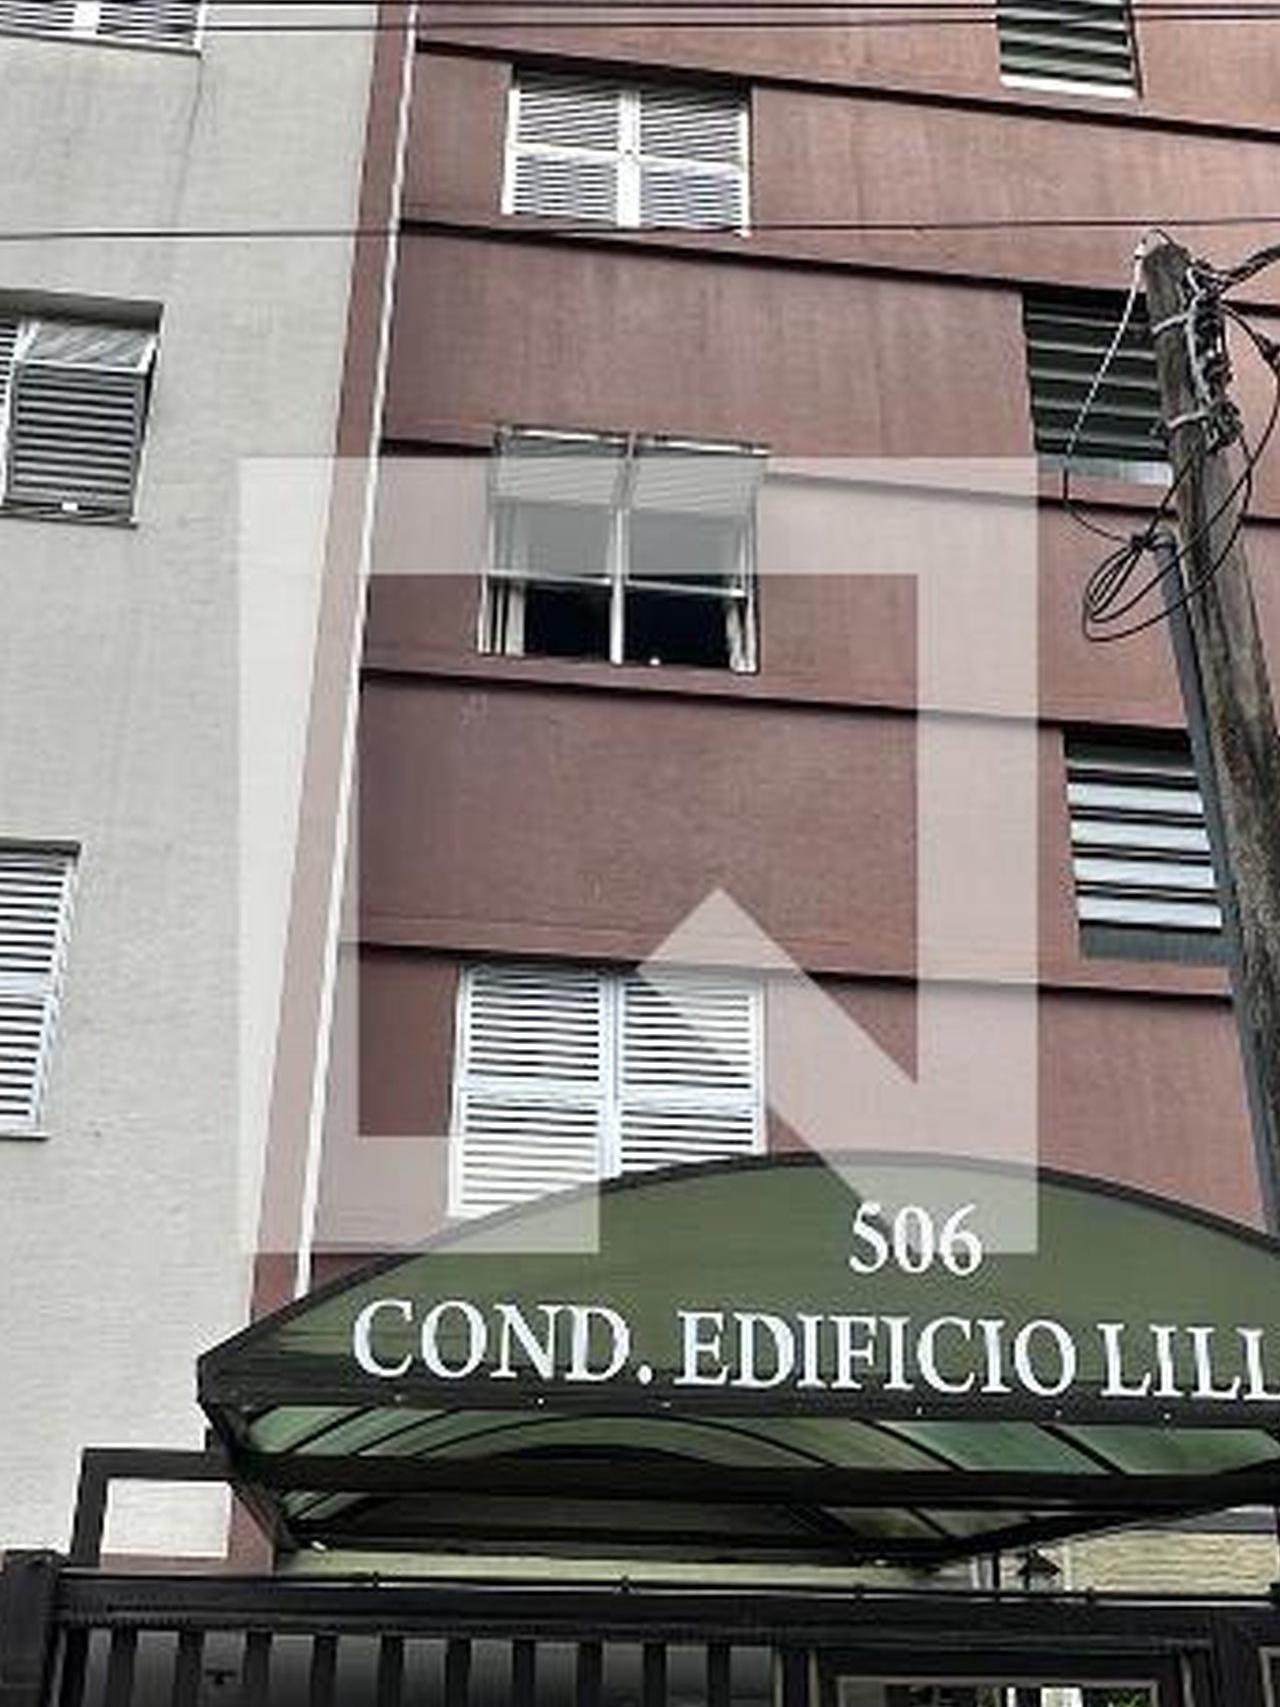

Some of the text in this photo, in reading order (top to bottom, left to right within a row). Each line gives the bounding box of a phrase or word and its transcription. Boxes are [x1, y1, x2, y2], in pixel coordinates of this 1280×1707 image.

[849, 1203, 985, 1276] 506
[351, 1298, 652, 1385] COND.
[675, 1309, 1079, 1397] EDIFICIO
